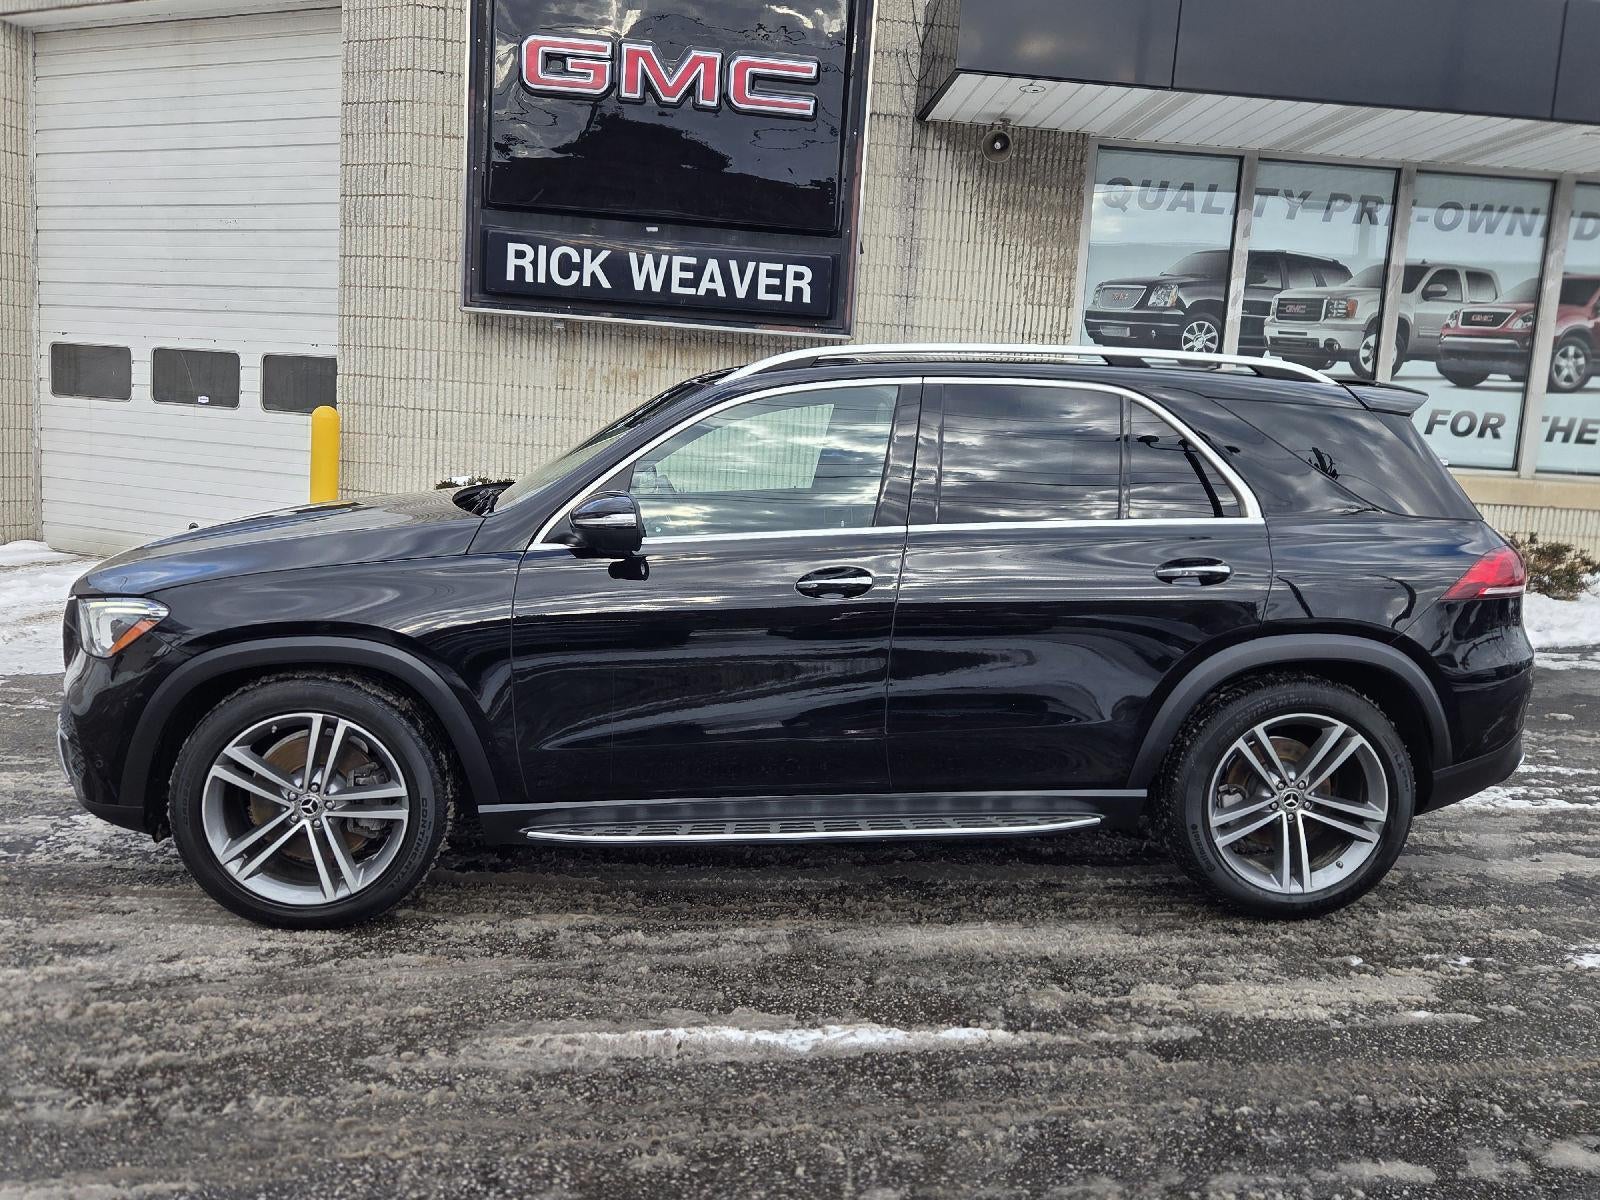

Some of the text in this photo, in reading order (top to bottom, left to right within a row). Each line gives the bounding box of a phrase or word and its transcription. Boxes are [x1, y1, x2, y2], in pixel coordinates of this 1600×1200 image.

[520, 34, 820, 117] GMC
[1103, 176, 1600, 241] QUALTY PR-OWND
[505, 242, 814, 304] RICK WEAVER
[1424, 409, 1506, 440] FOR
